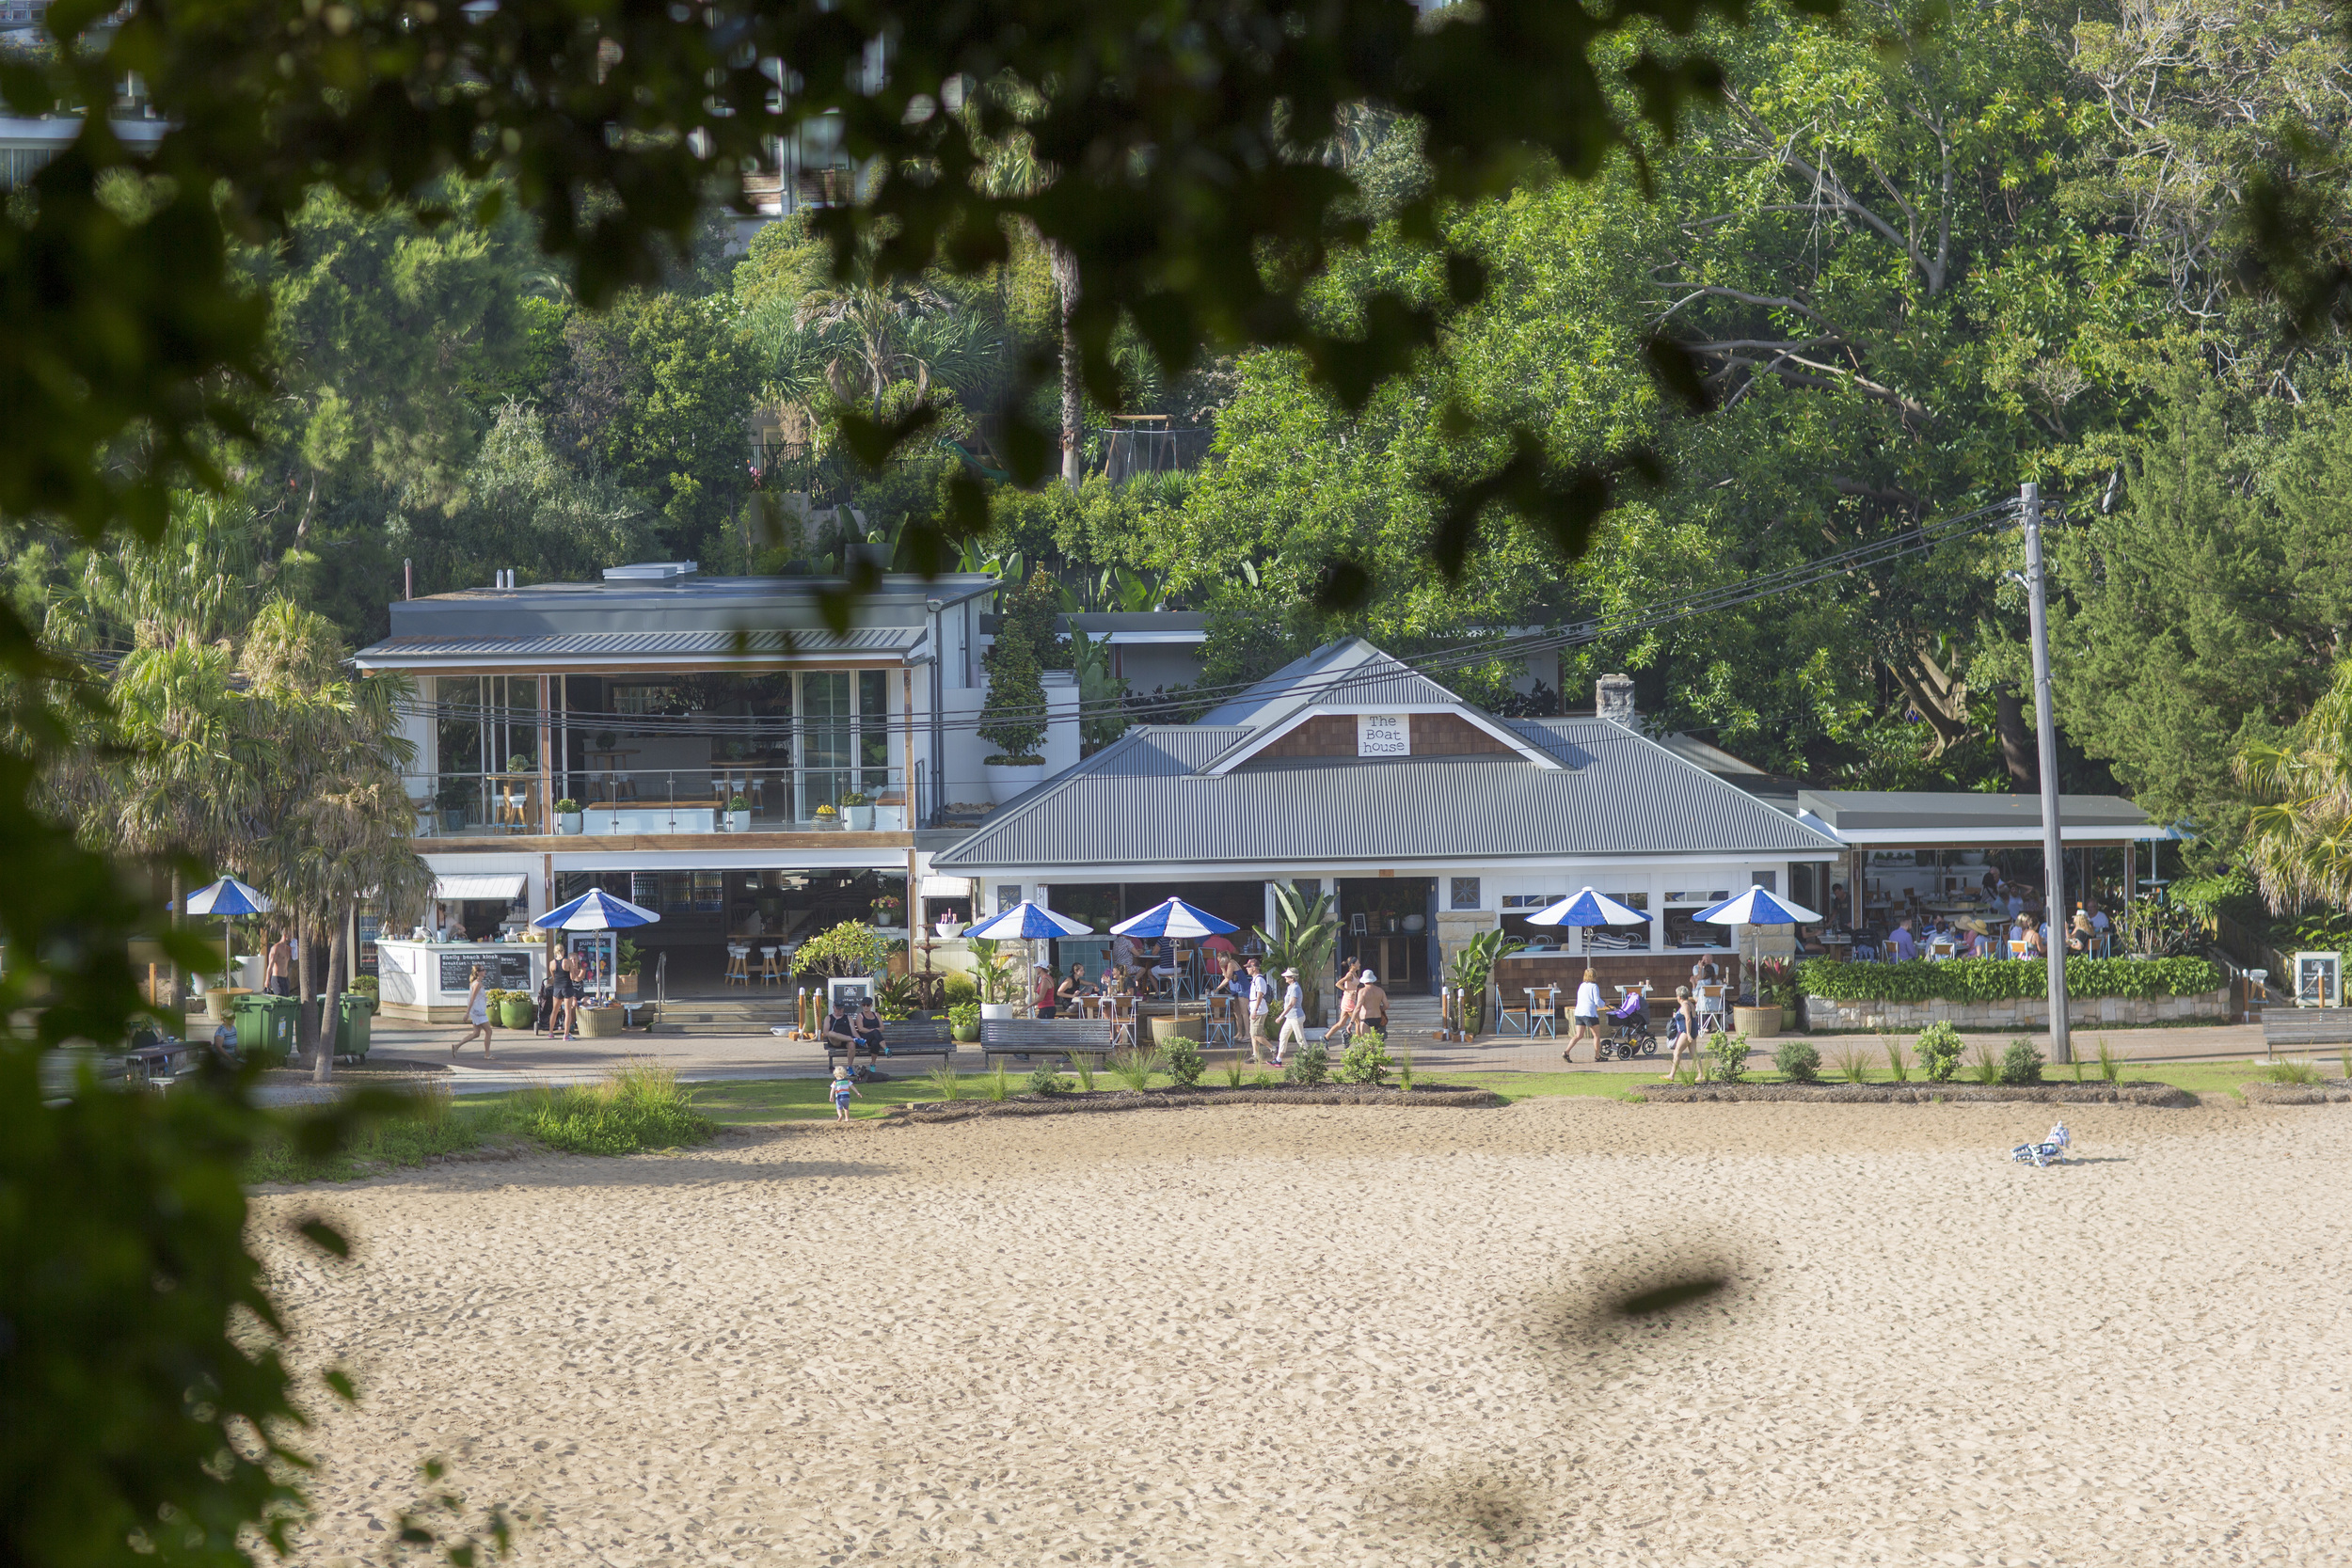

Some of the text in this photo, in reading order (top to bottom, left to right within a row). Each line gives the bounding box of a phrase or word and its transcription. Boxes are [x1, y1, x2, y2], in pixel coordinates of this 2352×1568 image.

[1369, 715, 1397, 727] The
[1366, 729, 1402, 740] Boat
[1363, 741, 1405, 753] house
